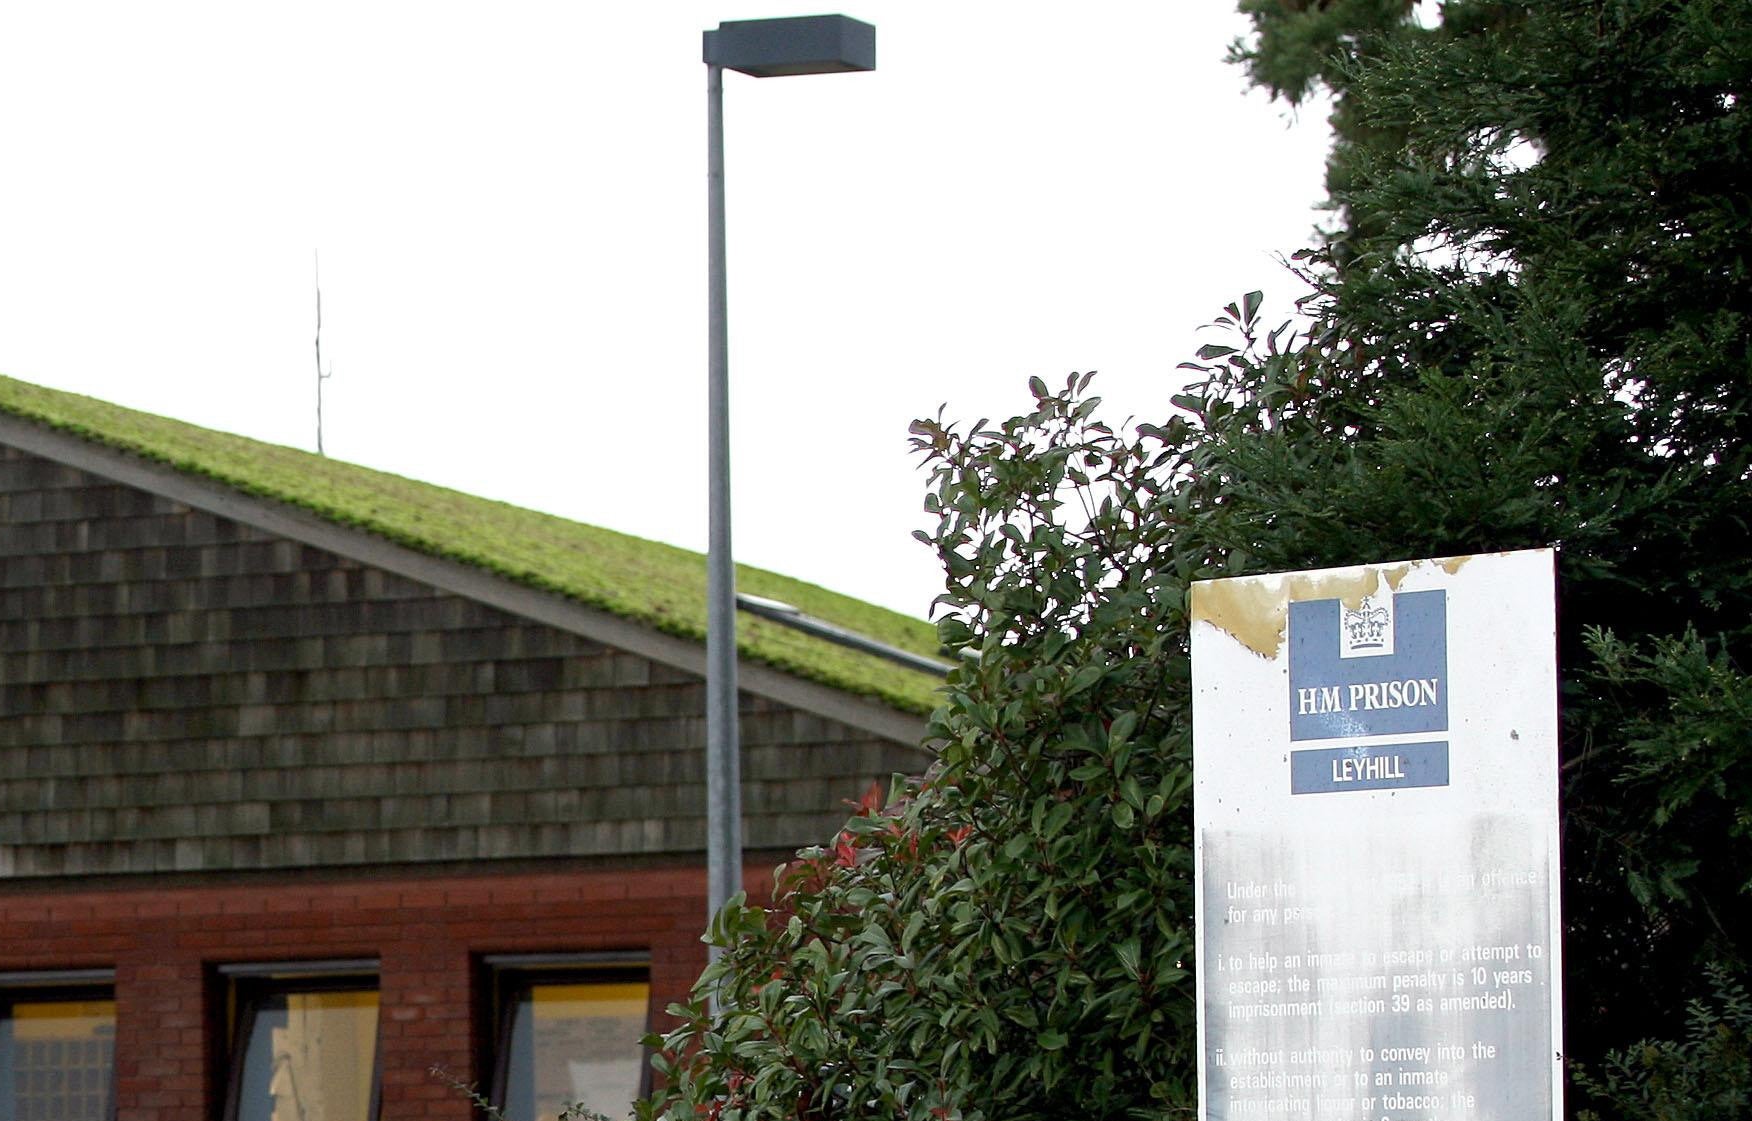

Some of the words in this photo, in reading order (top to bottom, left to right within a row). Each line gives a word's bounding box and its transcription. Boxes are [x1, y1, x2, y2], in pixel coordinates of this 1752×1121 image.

[1298, 686, 1342, 715] HM
[1349, 678, 1438, 711] PRISON
[1332, 756, 1405, 782] LEYHILL
[1227, 881, 1267, 899] Under
[1228, 906, 1247, 924] for
[1253, 907, 1277, 925] any
[1229, 954, 1243, 970] to
[1249, 952, 1277, 973] help
[1284, 954, 1301, 969] an
[1462, 943, 1520, 963] attempt
[1526, 943, 1542, 959] to
[1288, 975, 1311, 992] the
[1393, 971, 1446, 992] penalty
[1453, 967, 1465, 986] is
[1471, 966, 1487, 985] 10
[1228, 999, 1323, 1021] imprisonment
[1391, 994, 1410, 1012] 39
[1416, 998, 1433, 1012] as
[1440, 989, 1516, 1012] amended).
[1230, 1047, 1283, 1065] without
[1360, 1046, 1374, 1062] to
[1380, 1047, 1431, 1064] convey
[1437, 1042, 1465, 1061] into
[1472, 1041, 1496, 1059] the
[1354, 1071, 1368, 1087] to
[1375, 1072, 1392, 1086] an
[1399, 1067, 1448, 1087] inmate
[1362, 1097, 1376, 1111] or
